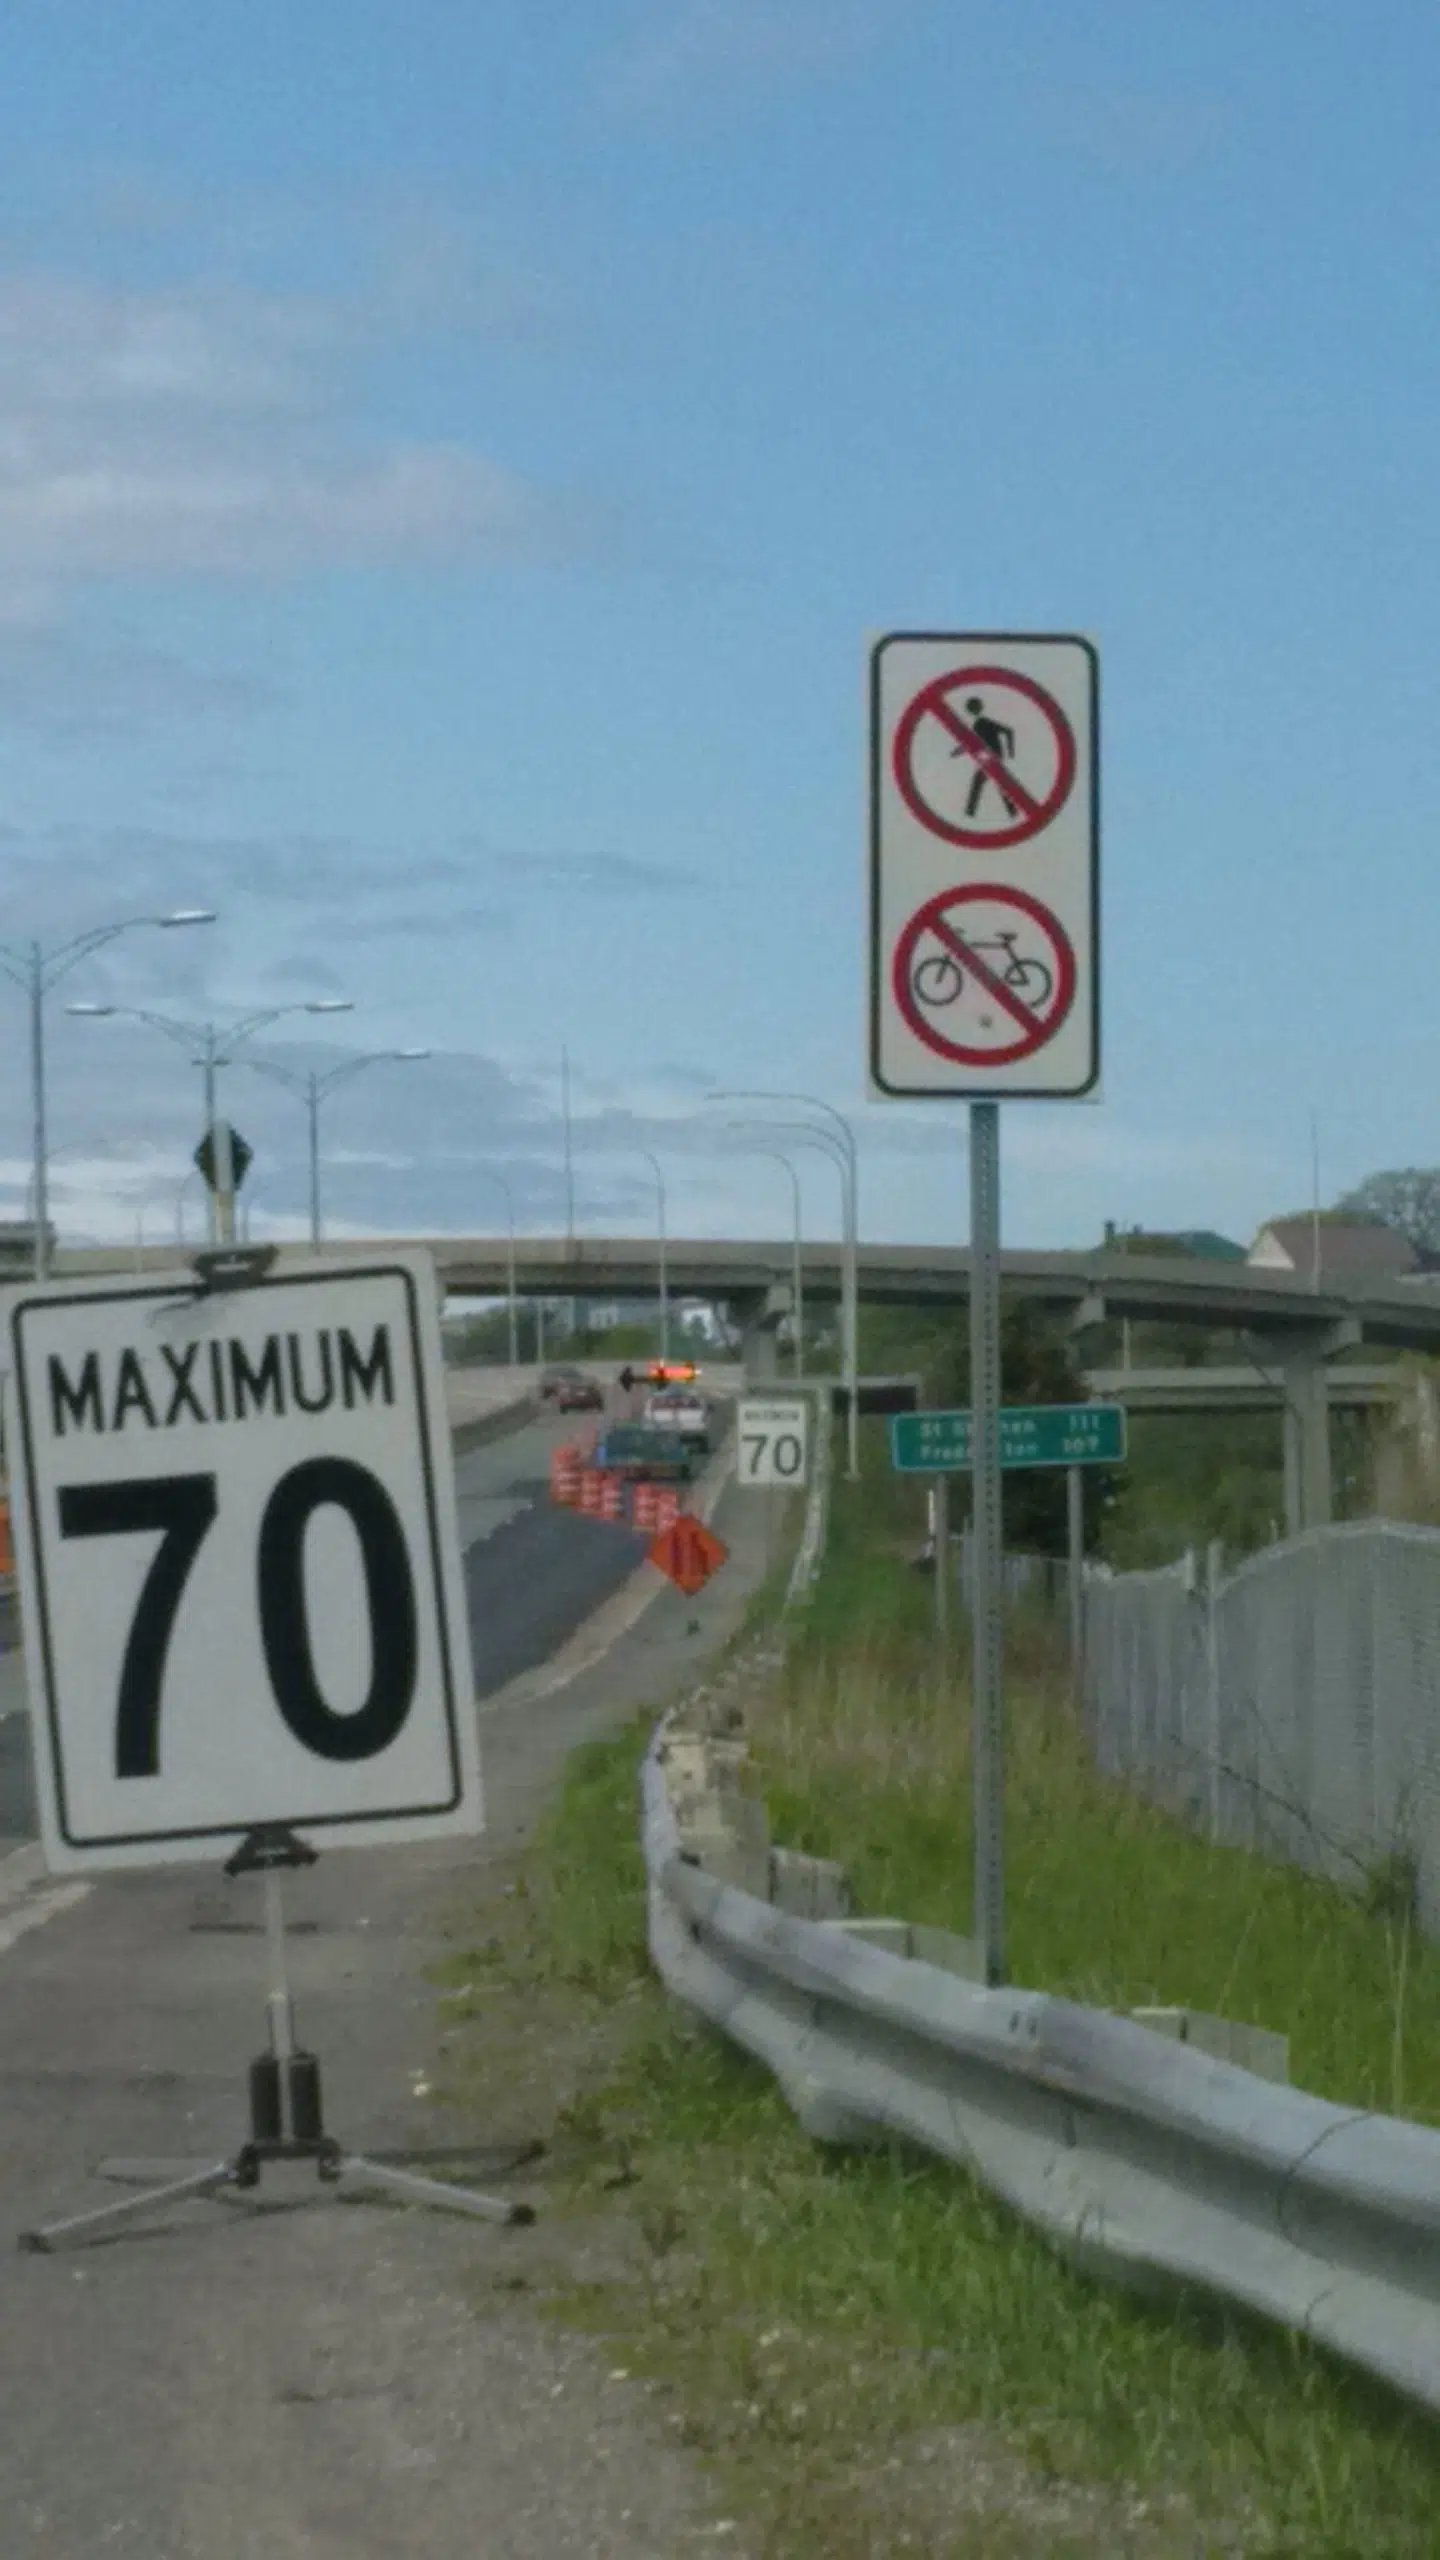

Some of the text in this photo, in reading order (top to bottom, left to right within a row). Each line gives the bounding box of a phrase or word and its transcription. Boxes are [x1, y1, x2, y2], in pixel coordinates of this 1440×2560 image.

[47, 1323, 395, 1437] MAXIMUM
[741, 1434, 802, 1477] 70
[920, 1441, 1038, 1460] Fredton
[57, 1455, 419, 1778] 70
